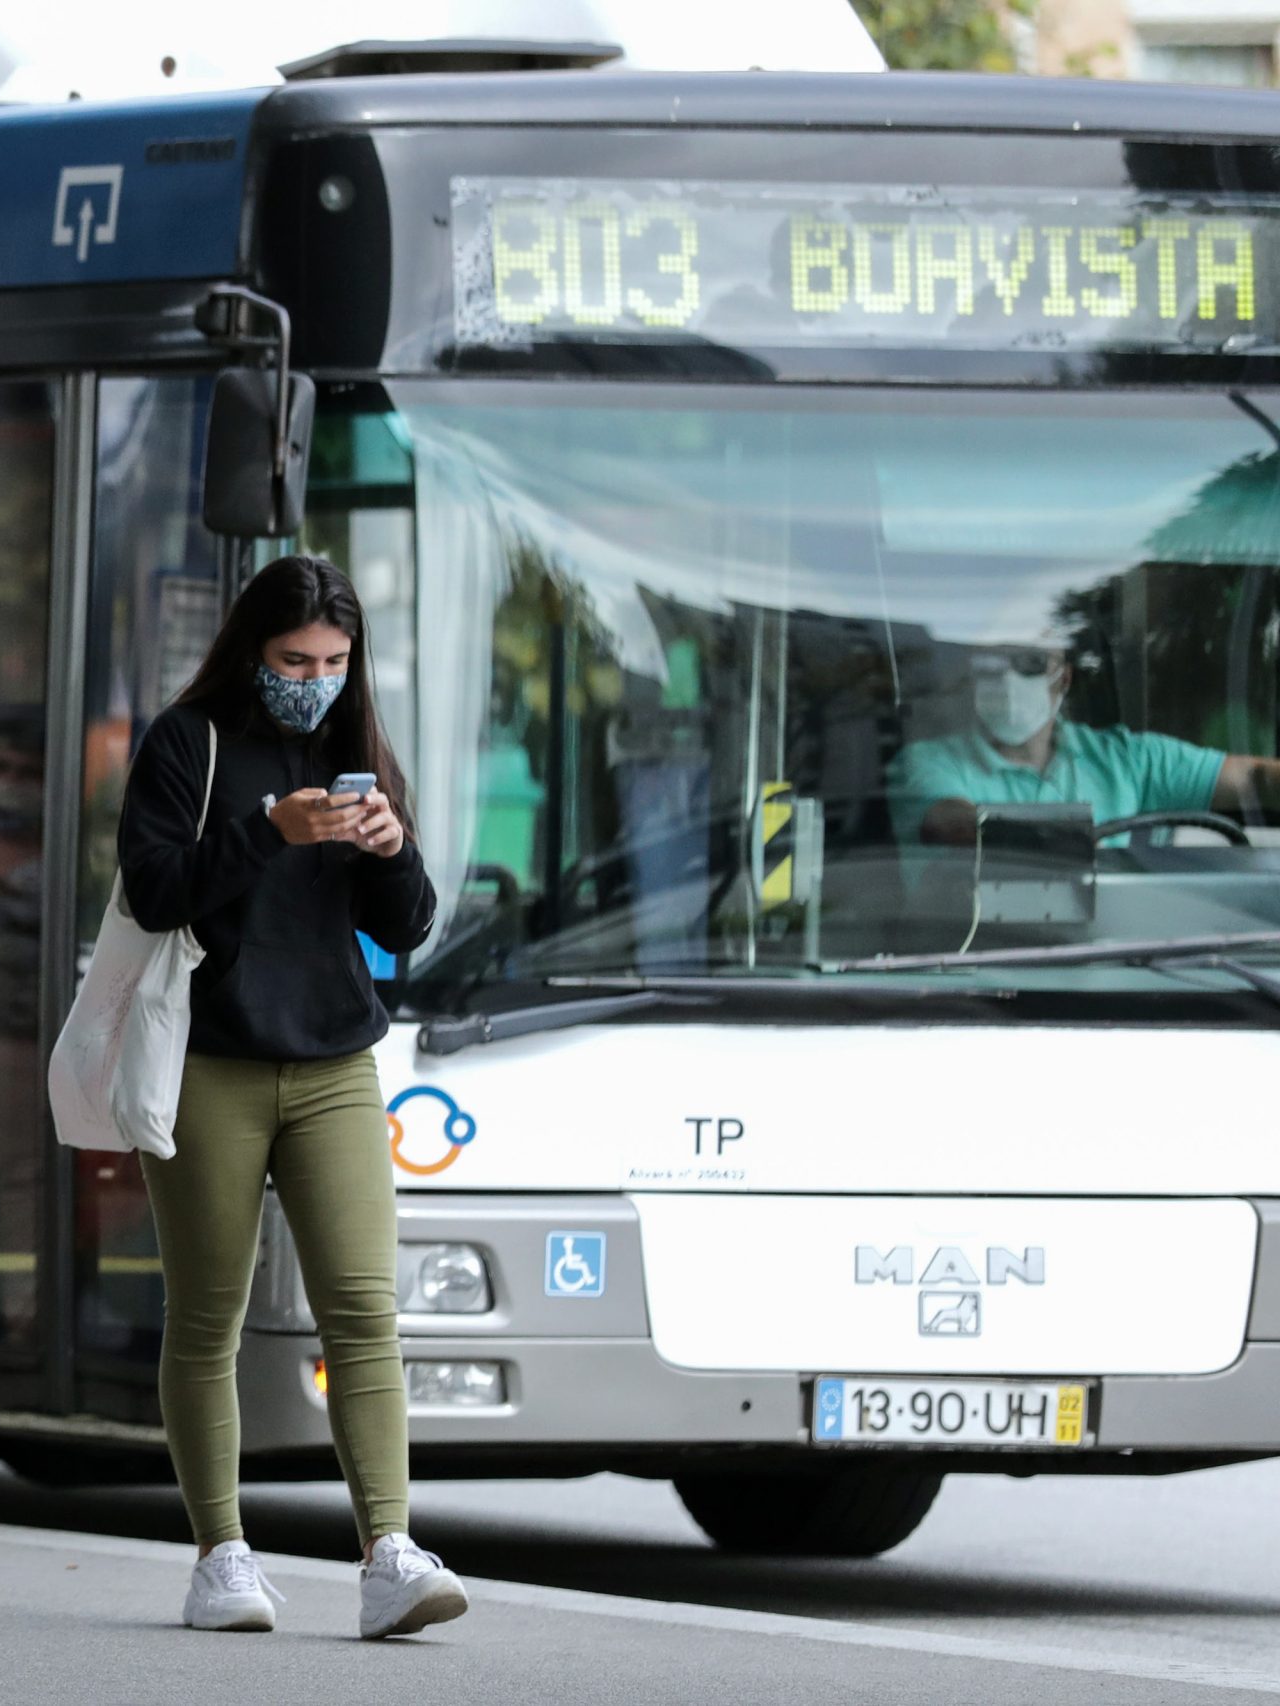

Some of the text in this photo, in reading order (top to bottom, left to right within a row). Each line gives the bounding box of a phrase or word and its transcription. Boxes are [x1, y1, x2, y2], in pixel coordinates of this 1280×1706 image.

[494, 204, 1257, 326] 803 BOAVISTA
[684, 1117, 745, 1156] TP
[854, 1245, 1046, 1286] MAN
[1059, 1393, 1081, 1412] 02
[1058, 1423, 1079, 1441] 11
